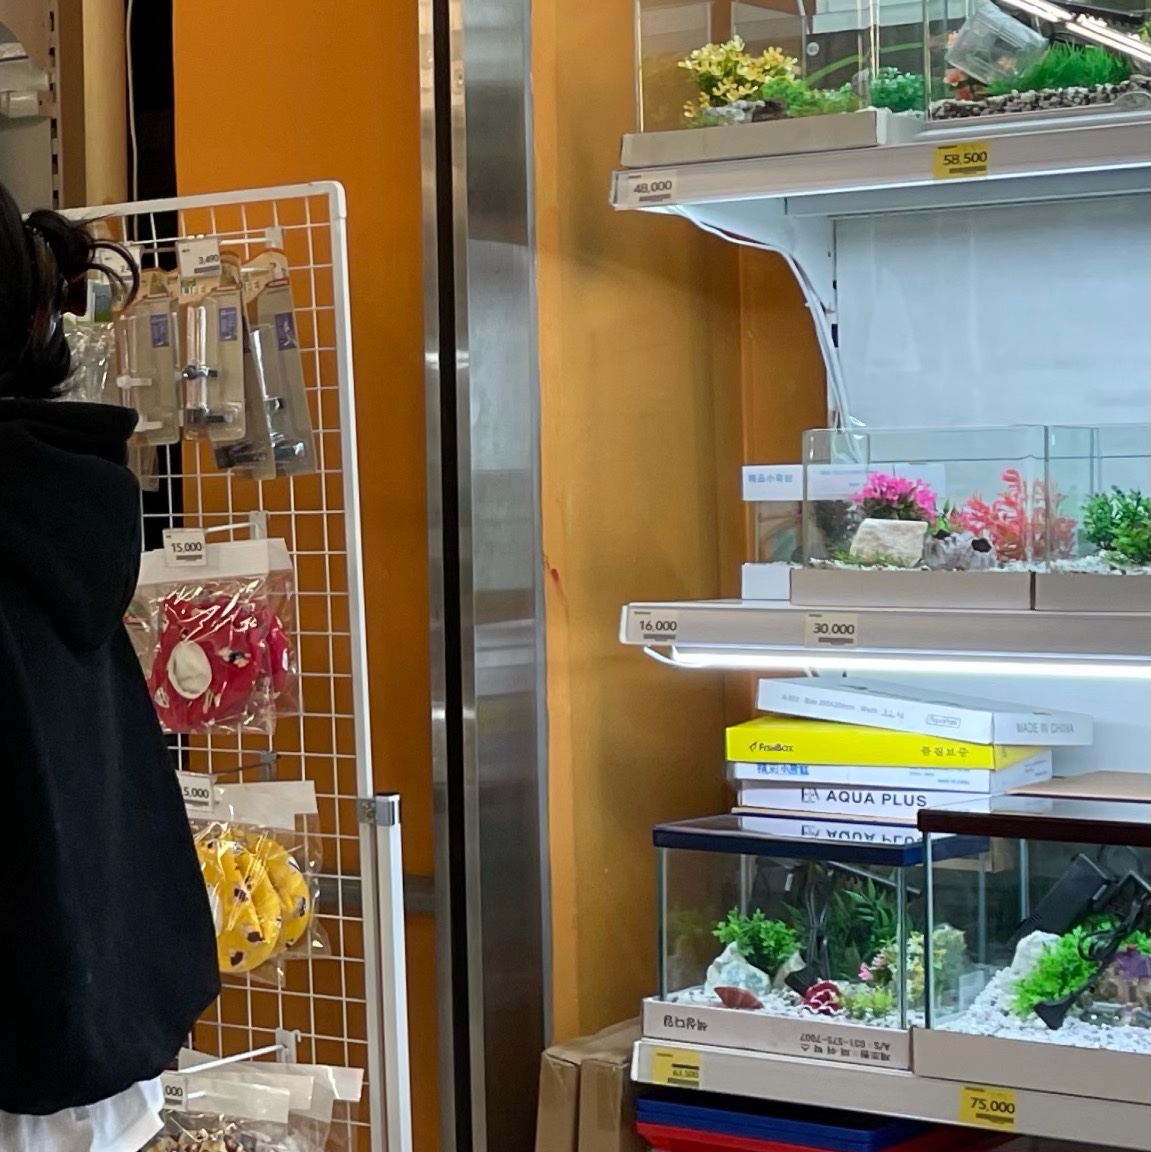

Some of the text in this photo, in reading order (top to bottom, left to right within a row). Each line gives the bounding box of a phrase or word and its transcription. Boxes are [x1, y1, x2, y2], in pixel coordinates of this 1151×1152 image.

[943, 151, 988, 166] 58,500
[633, 180, 672, 194] 48,000
[198, 254, 219, 265] 3,490
[171, 541, 202, 553] 15,000
[639, 619, 677, 632] 16,000
[813, 622, 855, 635] 30,000
[1016, 722, 1075, 734] MADE IN CHINA
[826, 790, 927, 807] AQUA PLUS
[970, 1096, 1015, 1114] 75,000
